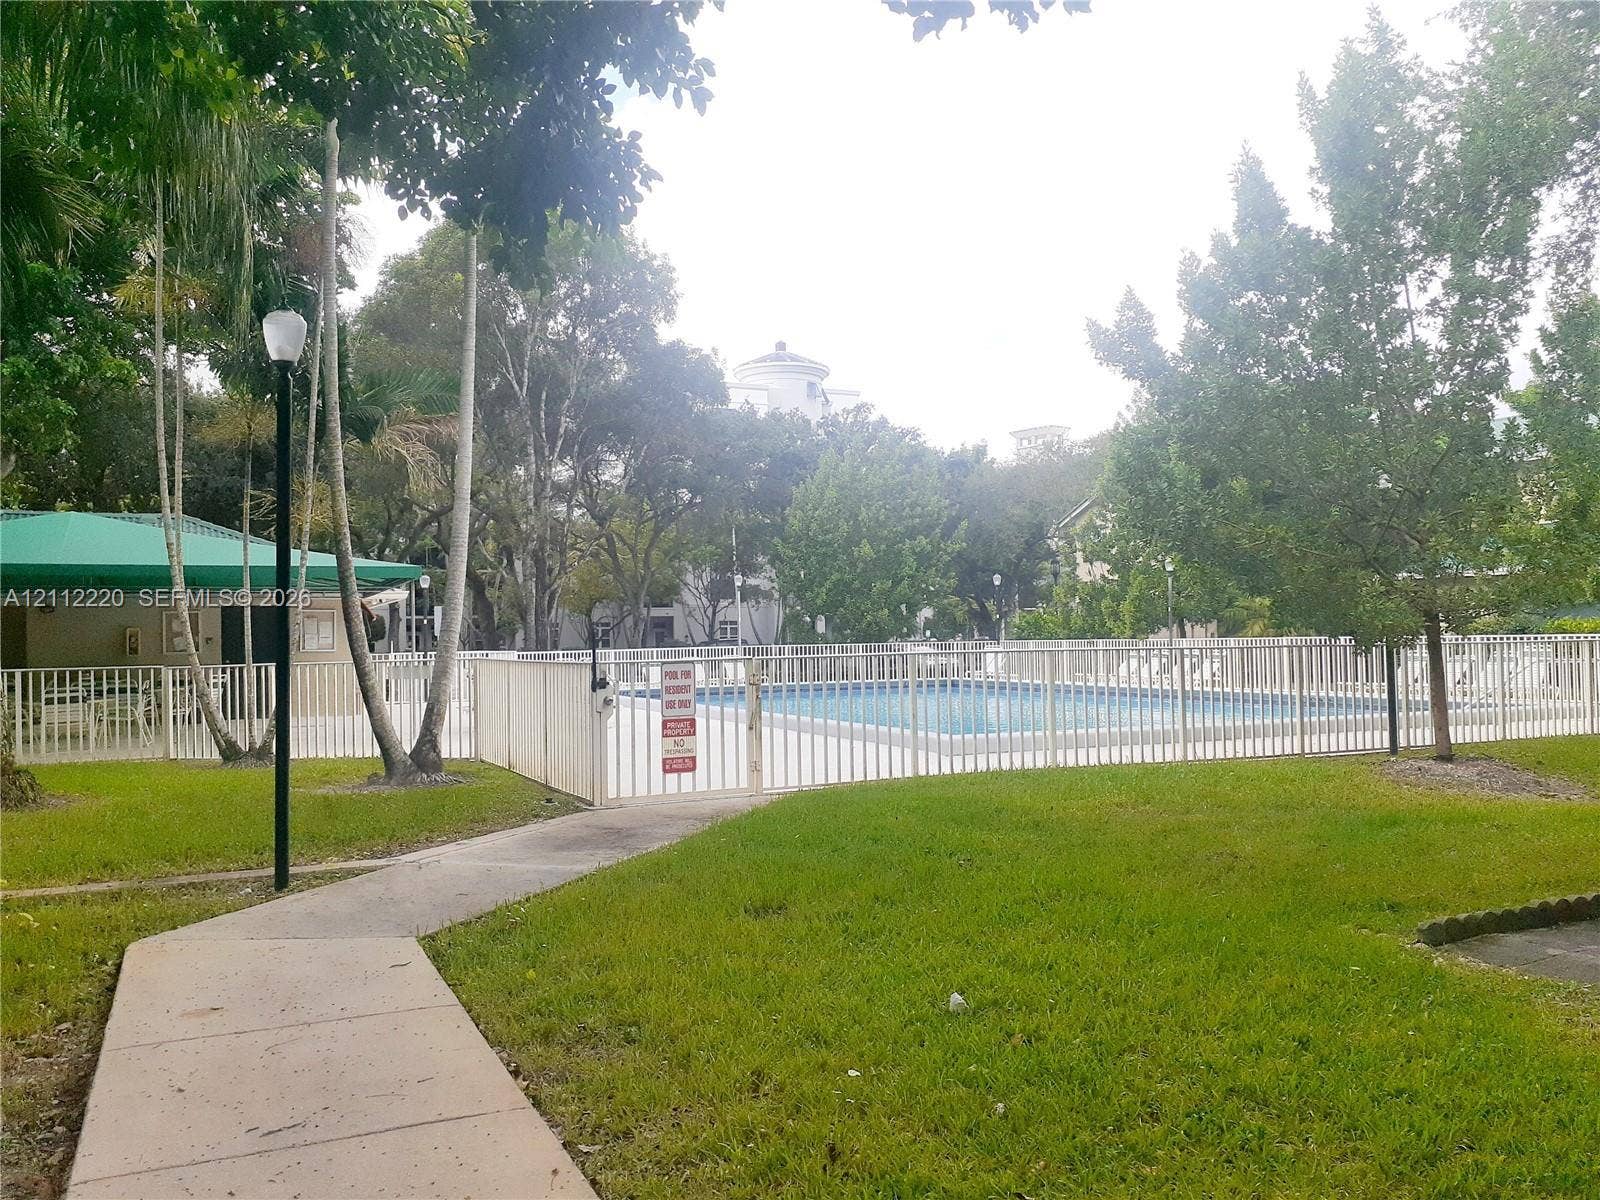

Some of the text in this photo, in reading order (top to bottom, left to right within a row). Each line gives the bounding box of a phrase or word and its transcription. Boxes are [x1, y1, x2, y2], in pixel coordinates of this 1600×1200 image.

[665, 670, 691, 680] POOL FOR
[665, 685, 691, 695] RESIDENT
[666, 699, 691, 709] USE ONLY
[667, 721, 690, 729] PRIVATE
[664, 728, 694, 736] PROPERTY
[673, 738, 685, 748] NO
